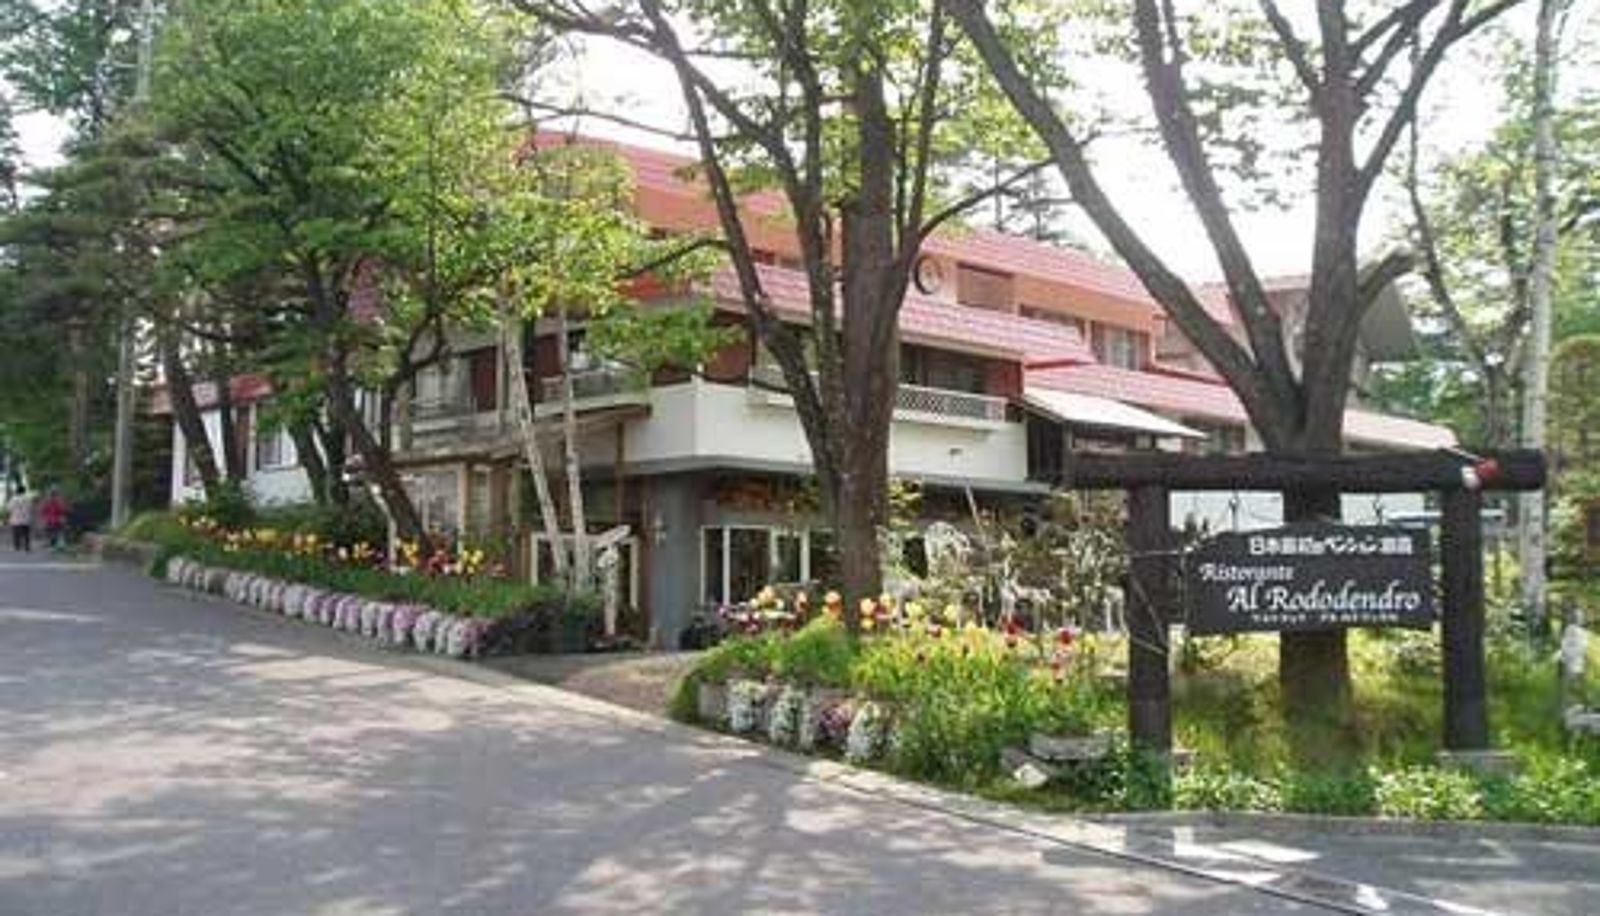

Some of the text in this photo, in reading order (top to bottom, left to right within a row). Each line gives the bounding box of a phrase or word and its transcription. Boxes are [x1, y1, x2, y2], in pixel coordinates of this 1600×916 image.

[1200, 563, 1294, 581] Ristorante
[1228, 579, 1421, 612] Al Rododendro
